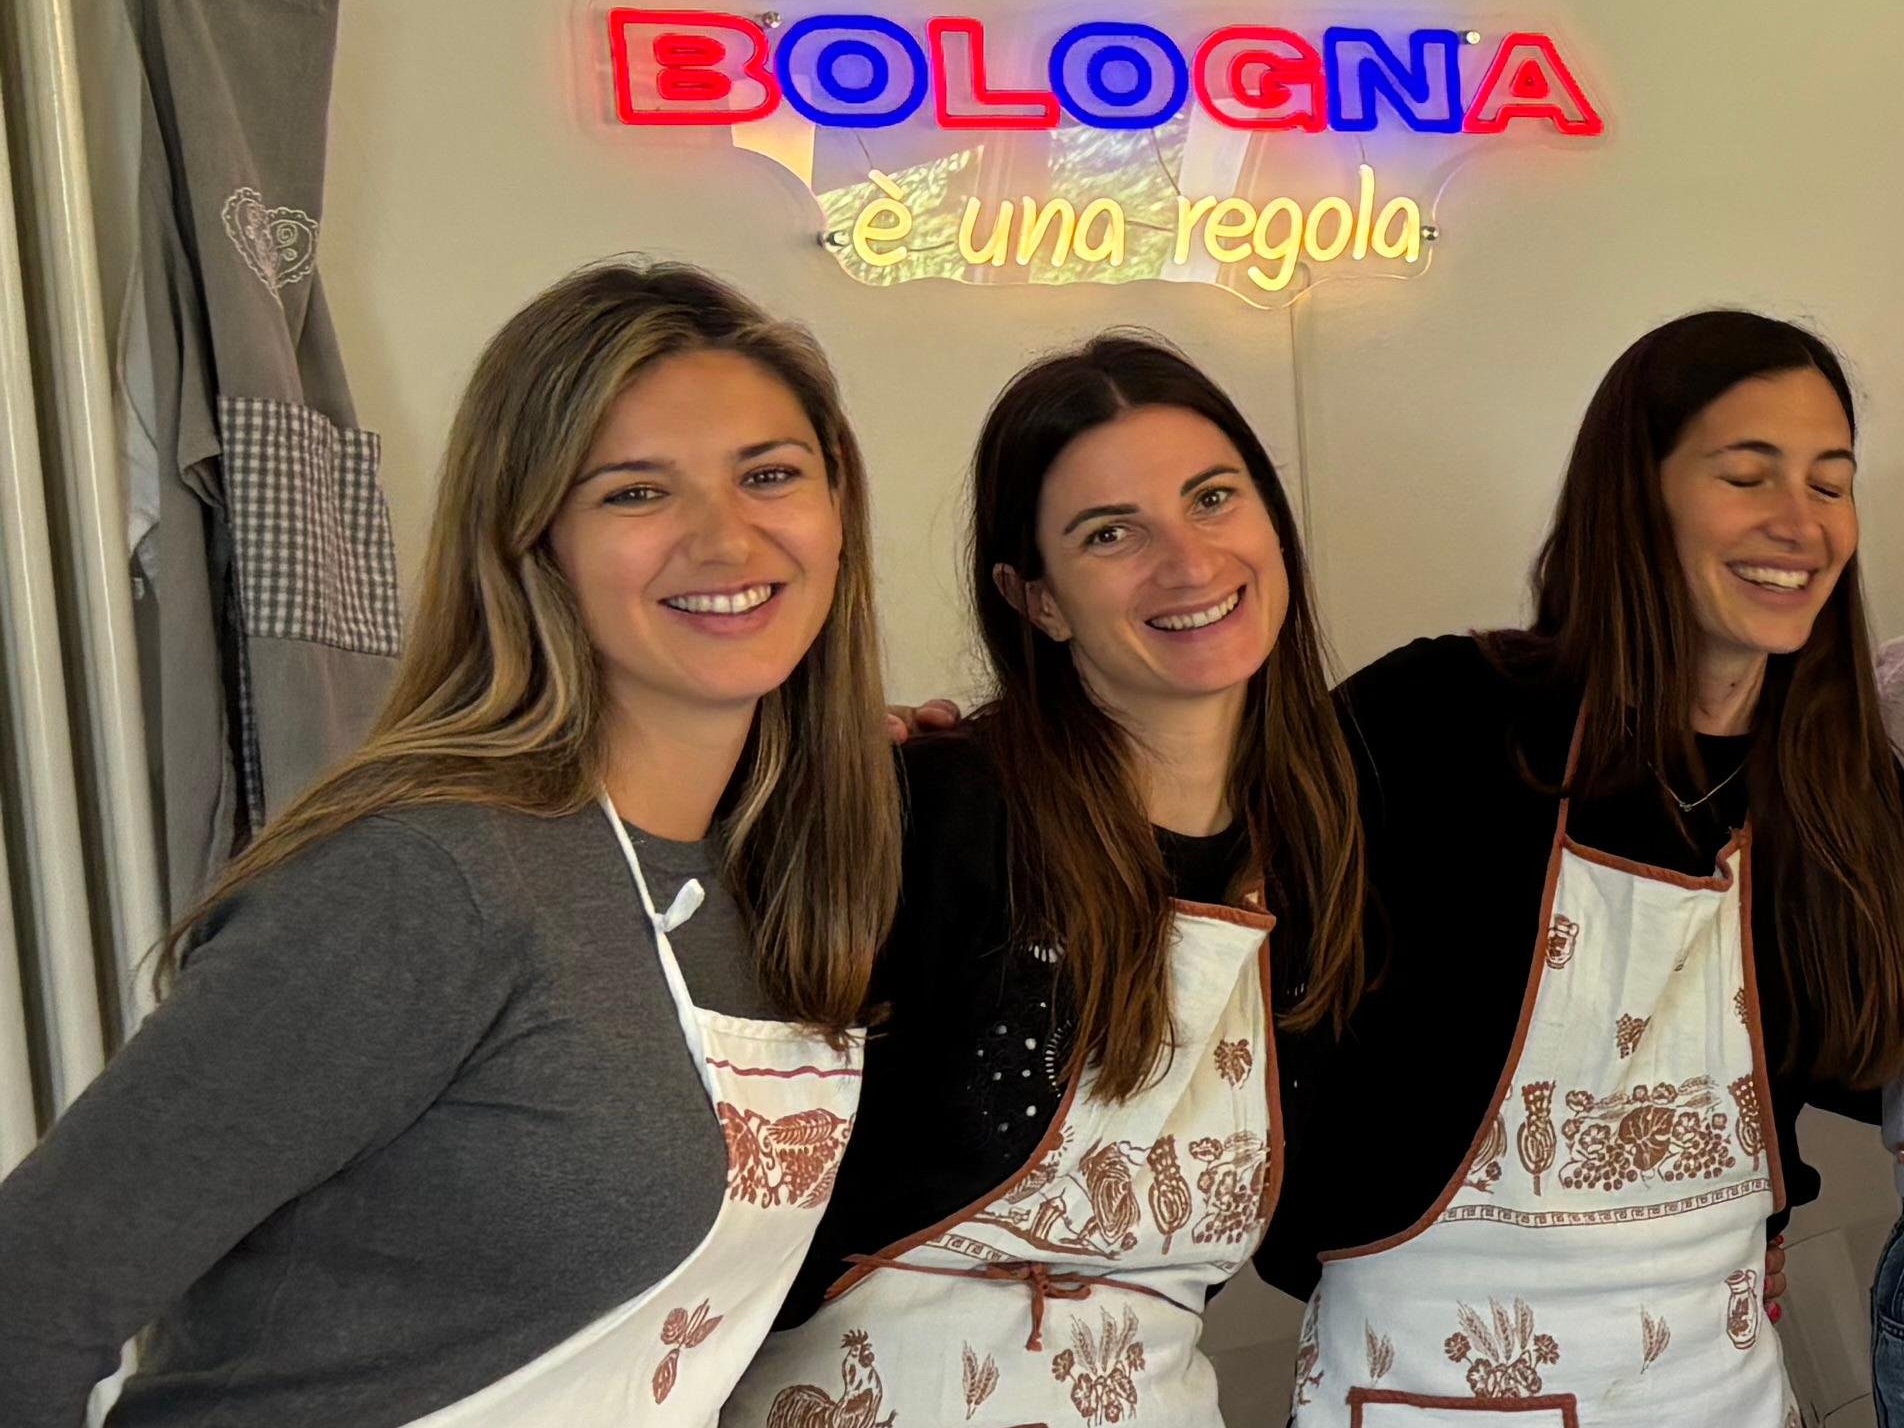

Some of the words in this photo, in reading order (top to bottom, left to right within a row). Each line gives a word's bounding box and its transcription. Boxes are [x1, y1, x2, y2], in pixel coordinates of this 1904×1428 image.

[606, 7, 1605, 137] BOLOGNA
[850, 167, 914, 267] è
[956, 190, 1128, 268] una
[1174, 164, 1422, 293] regola
